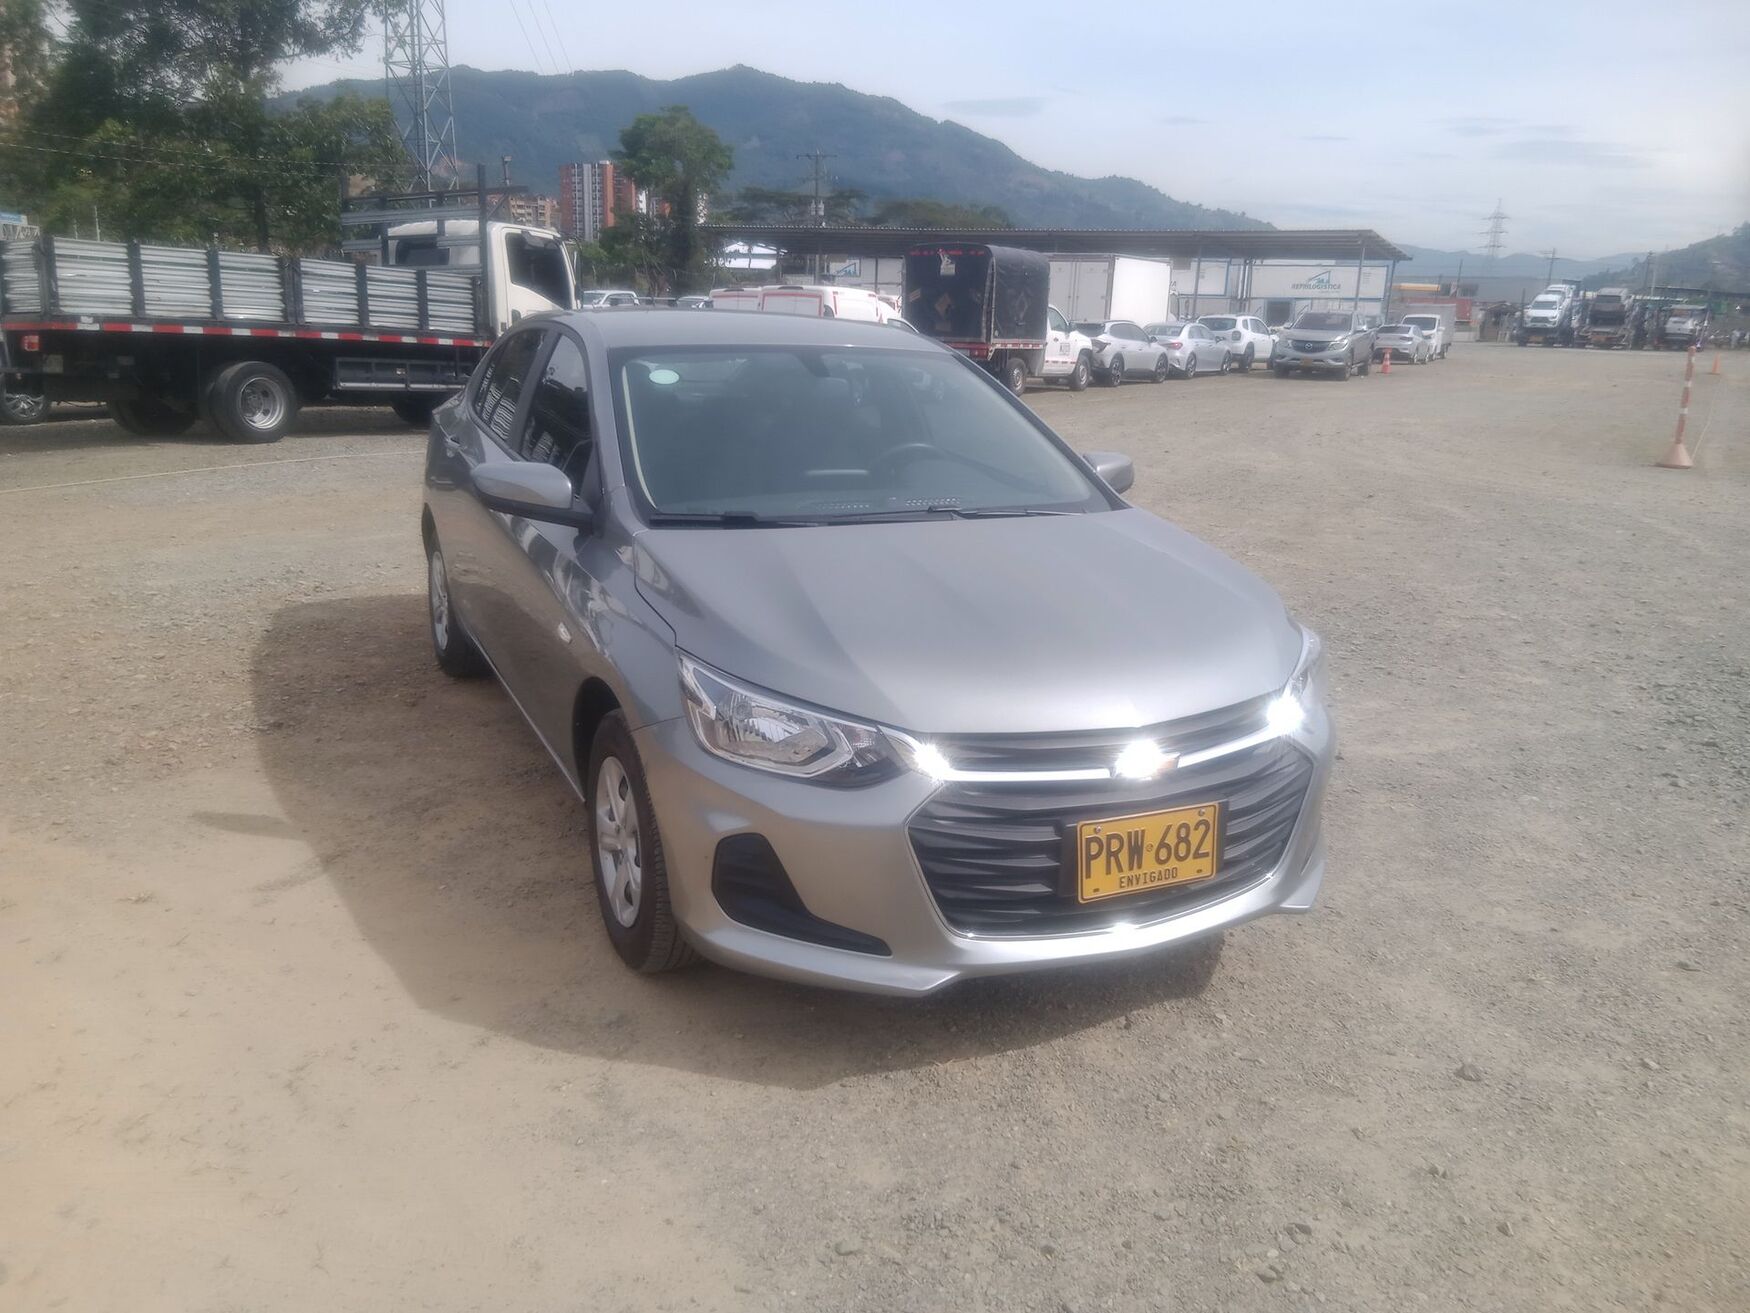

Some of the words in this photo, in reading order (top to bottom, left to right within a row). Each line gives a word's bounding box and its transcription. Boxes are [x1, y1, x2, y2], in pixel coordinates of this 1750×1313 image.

[1084, 828, 1146, 880] PRW
[1154, 818, 1211, 866] 682
[1119, 866, 1178, 889] ENVIGADO
